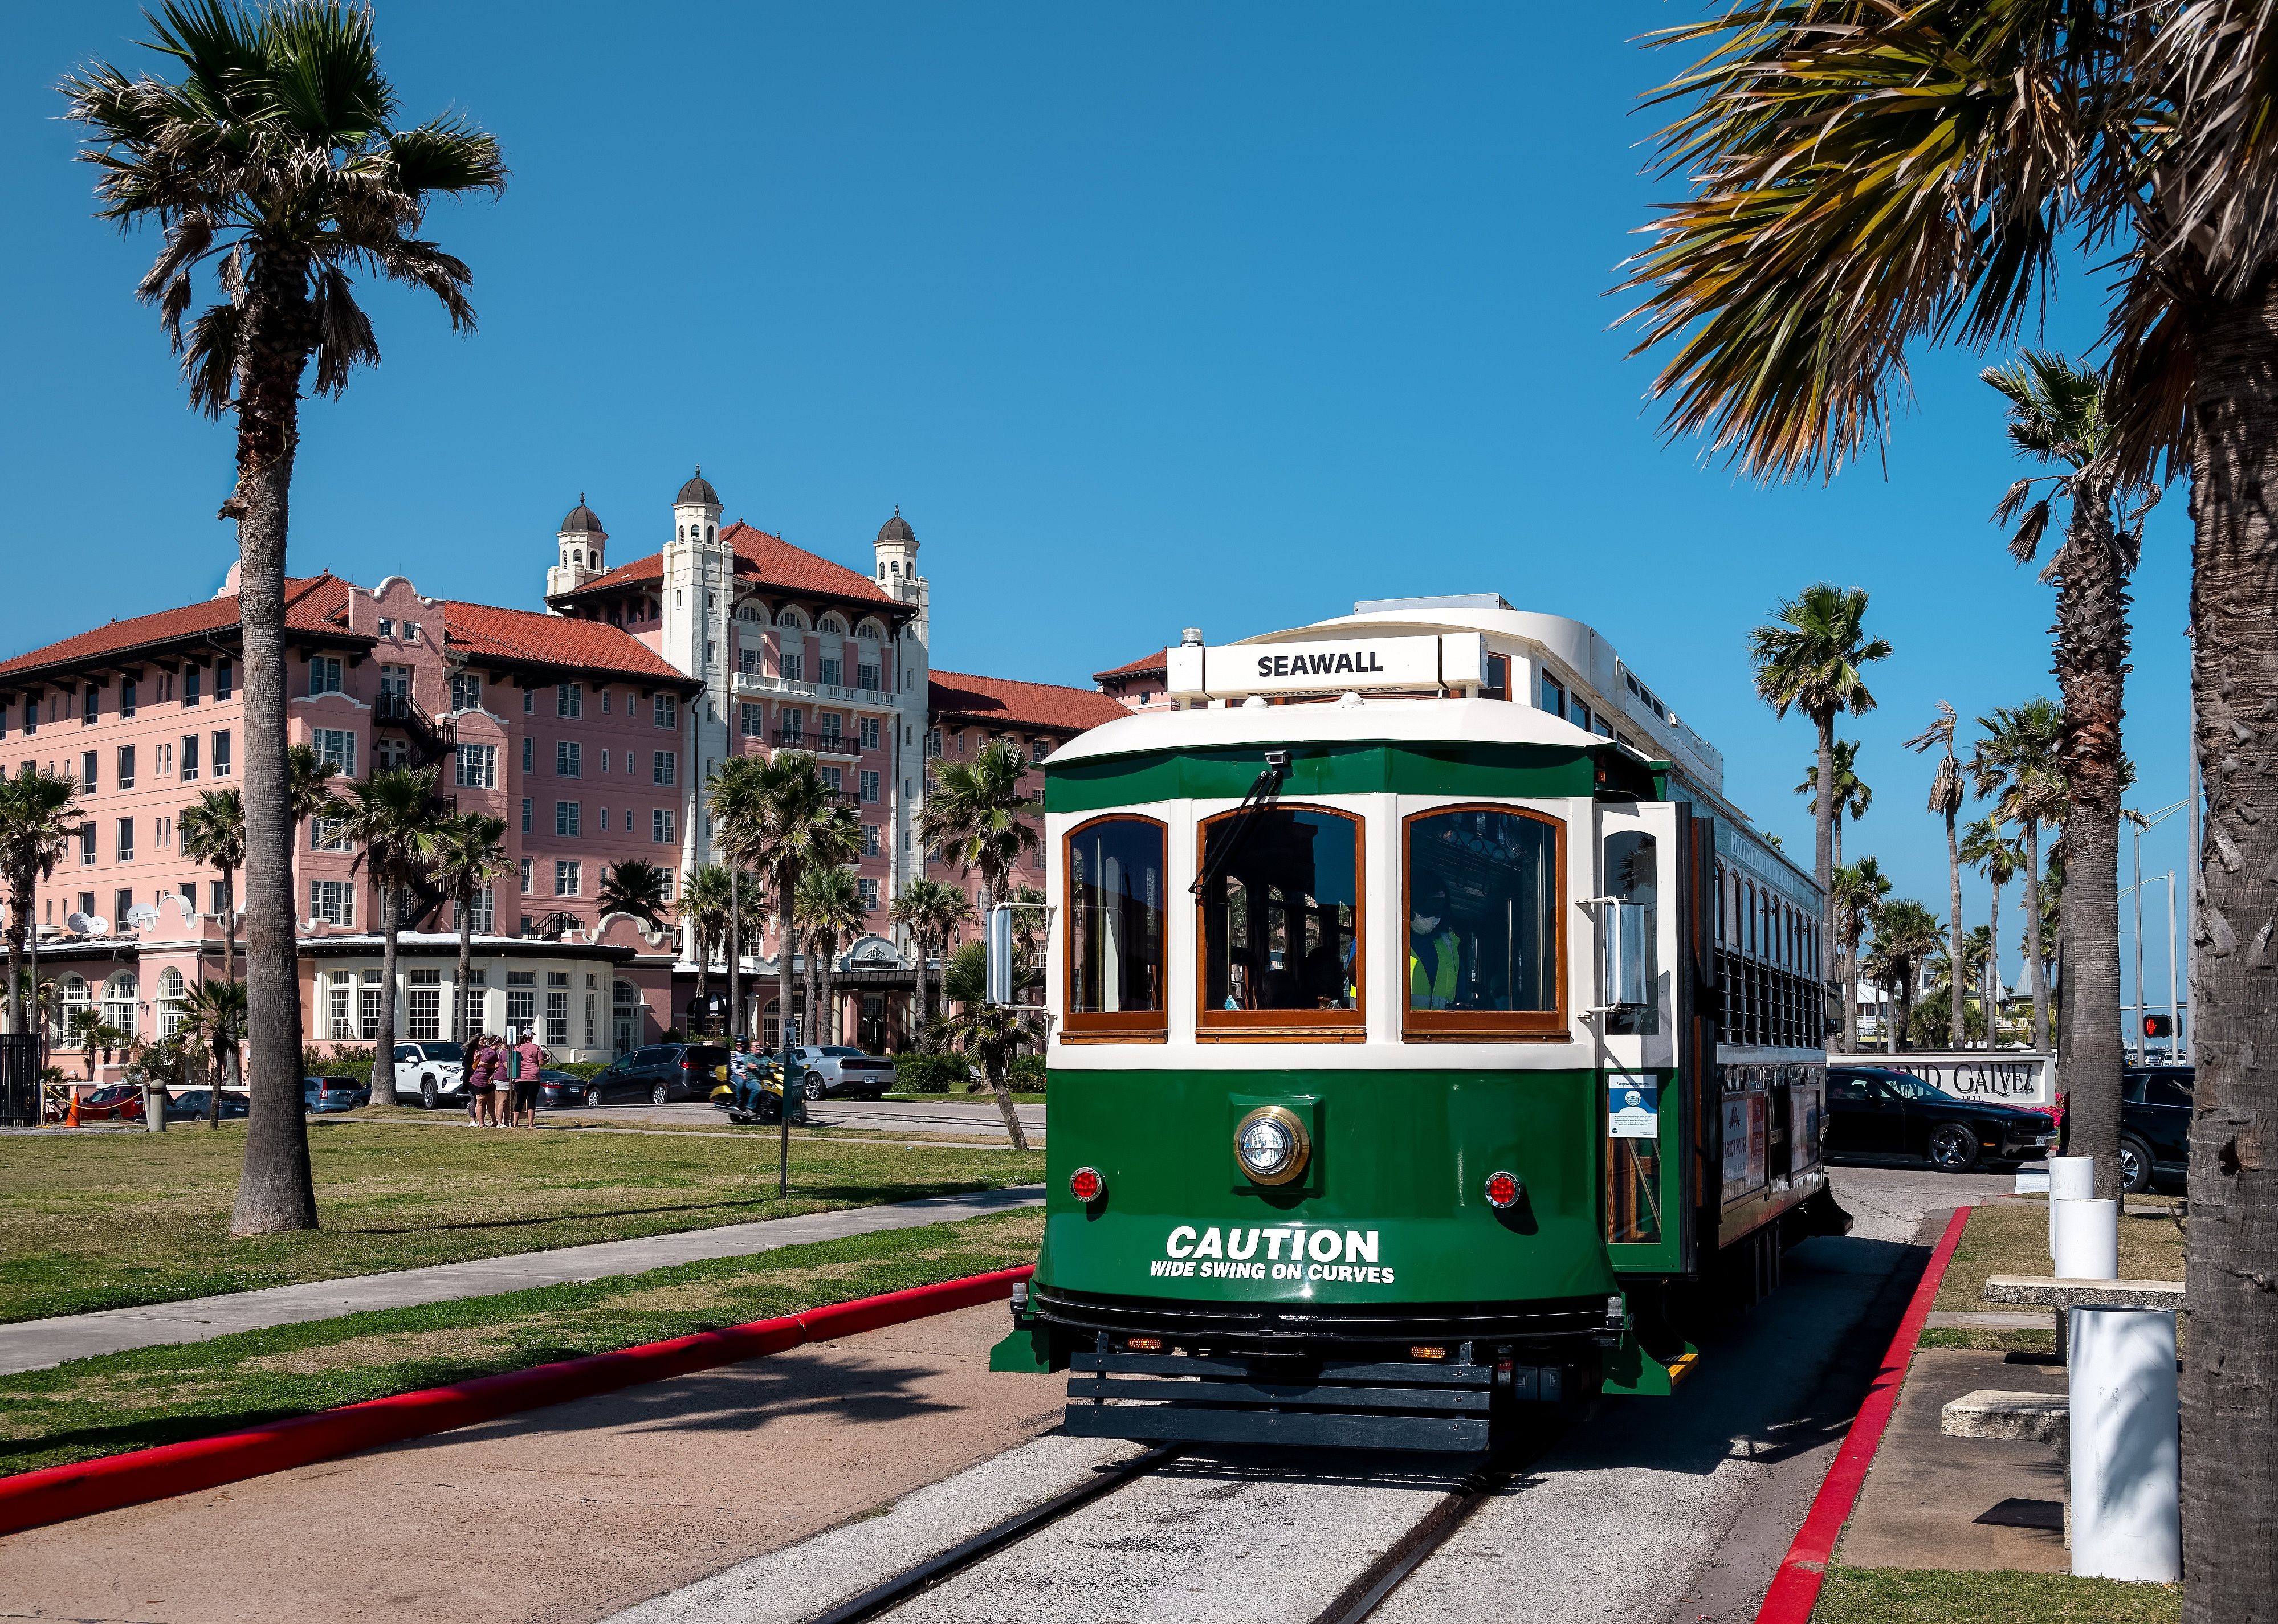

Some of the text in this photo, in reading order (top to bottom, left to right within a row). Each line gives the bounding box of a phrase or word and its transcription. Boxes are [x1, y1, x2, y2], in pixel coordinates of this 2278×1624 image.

[1258, 652, 1383, 678] SEAWALL
[1953, 1064, 2034, 1096] GALVEZ
[1166, 1226, 1379, 1263] CAUTION
[1151, 1260, 1395, 1284] WIDE SWING ON CURVES
